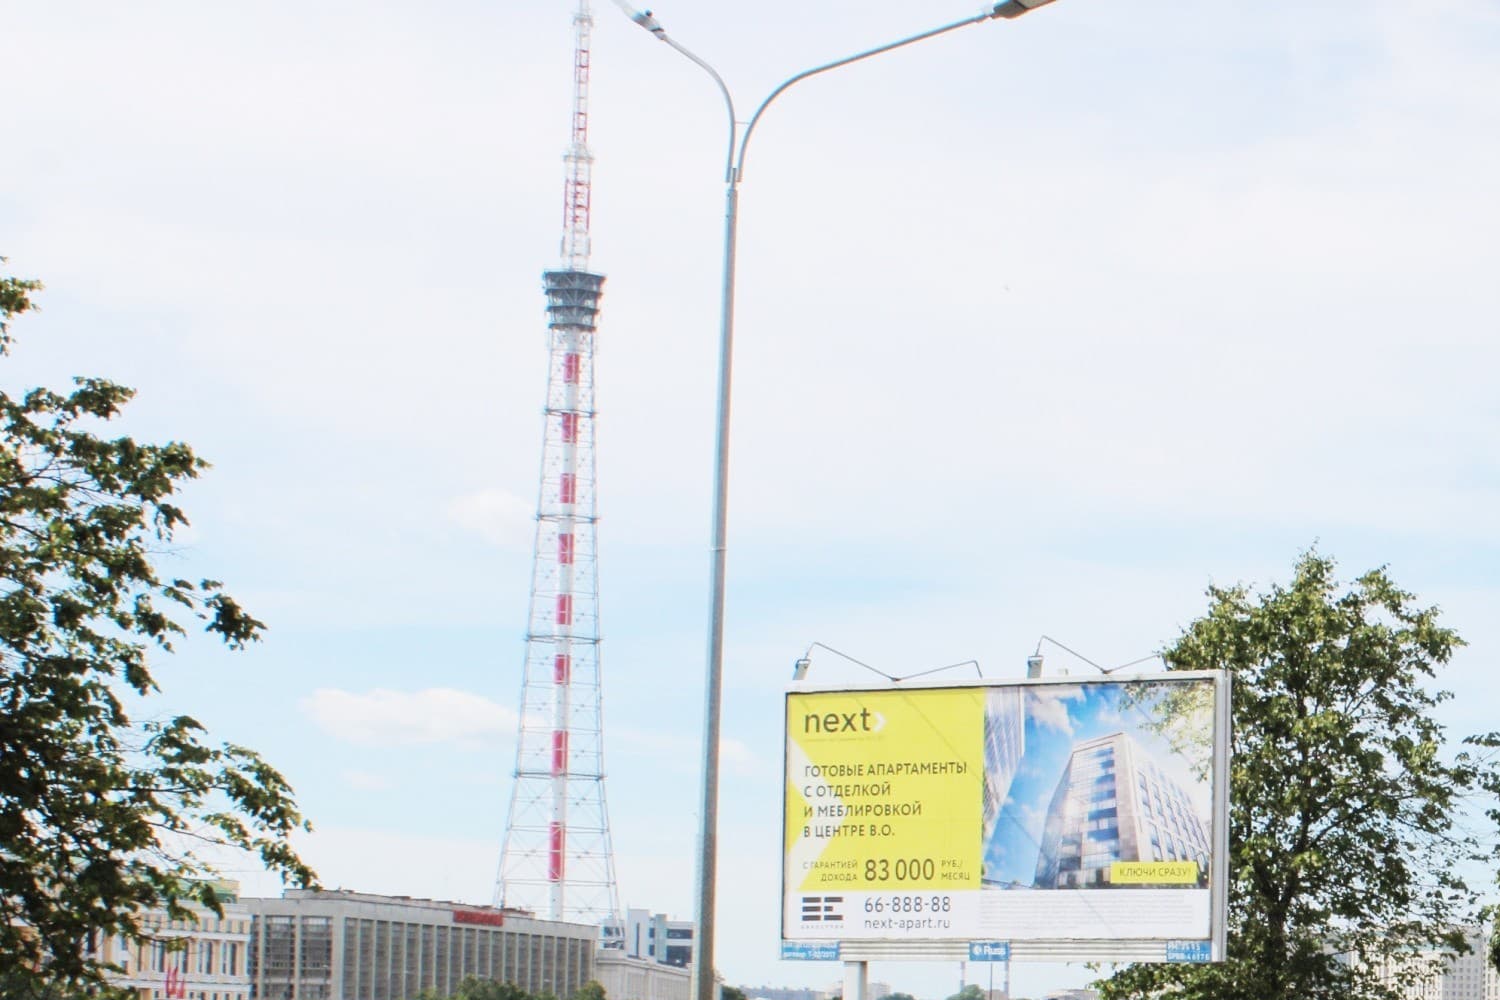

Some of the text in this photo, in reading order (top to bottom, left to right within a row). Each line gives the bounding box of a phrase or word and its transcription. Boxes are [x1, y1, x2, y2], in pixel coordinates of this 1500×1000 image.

[804, 708, 871, 733] next
[805, 762, 967, 778] ГОТОВЫЕ АПАРТАМЕНТЫ
[804, 781, 891, 798] С ОТДЕЛКОЙ
[804, 801, 922, 818] И МЕБЛИРОВКОЙ
[804, 824, 895, 839] В ЦЕНТРЕ В.О.
[810, 859, 858, 870] ГАРАНТИЕЙ
[864, 858, 935, 882] 83 000
[1119, 867, 1157, 878] КЛЮЧИ
[820, 873, 858, 882] ДОХОДА
[941, 871, 970, 882] МЕСЯЦ
[864, 896, 951, 913] 66-888-88
[864, 917, 951, 933] next-apart.ru
